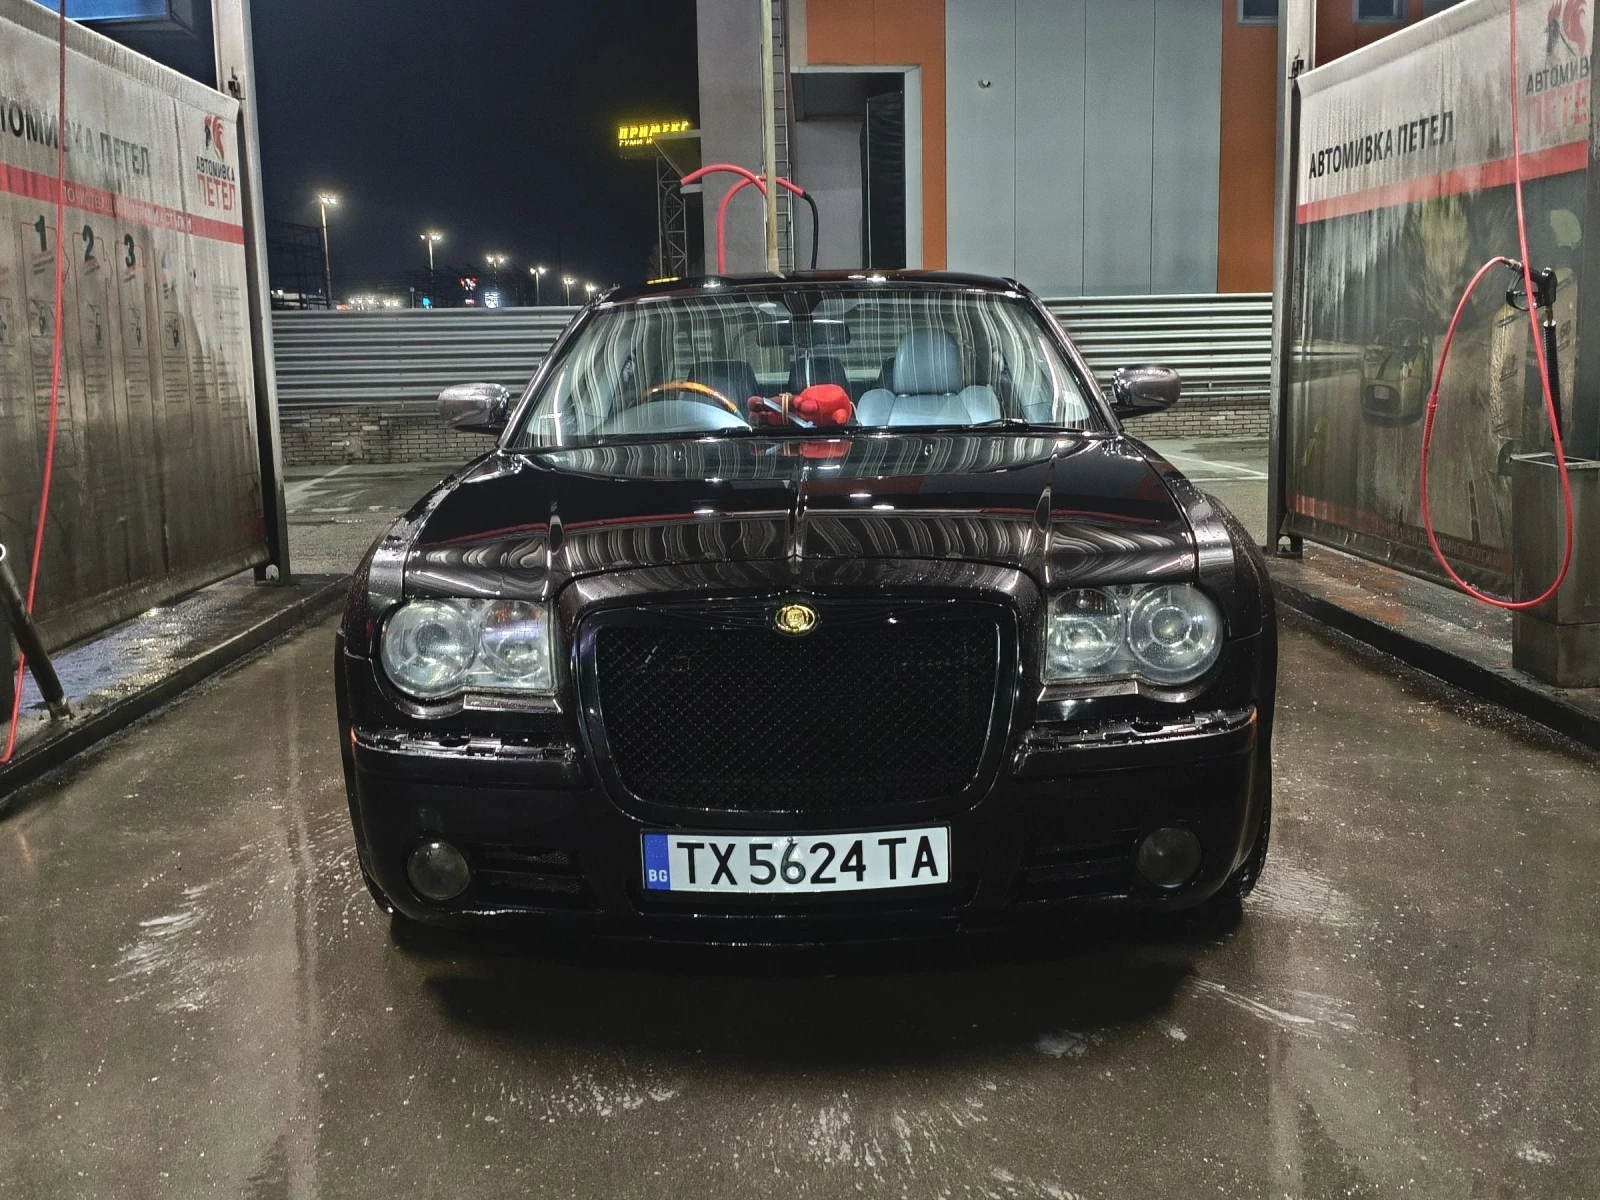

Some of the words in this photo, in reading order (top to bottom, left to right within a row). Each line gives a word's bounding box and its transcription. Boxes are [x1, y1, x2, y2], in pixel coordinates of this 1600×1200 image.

[1308, 129, 1393, 179] АВТОМИВКА
[1397, 110, 1454, 156] ПЕТЕЛ
[196, 155, 236, 182] АВТОМИВКА
[197, 173, 237, 212] ПЕТЕЛ
[34, 215, 47, 252] 1
[82, 224, 96, 262] 2
[124, 233, 136, 268] 3
[648, 869, 668, 882] BG
[676, 842, 738, 885] TX
[749, 839, 867, 885] 5624
[878, 835, 939, 880] TA
